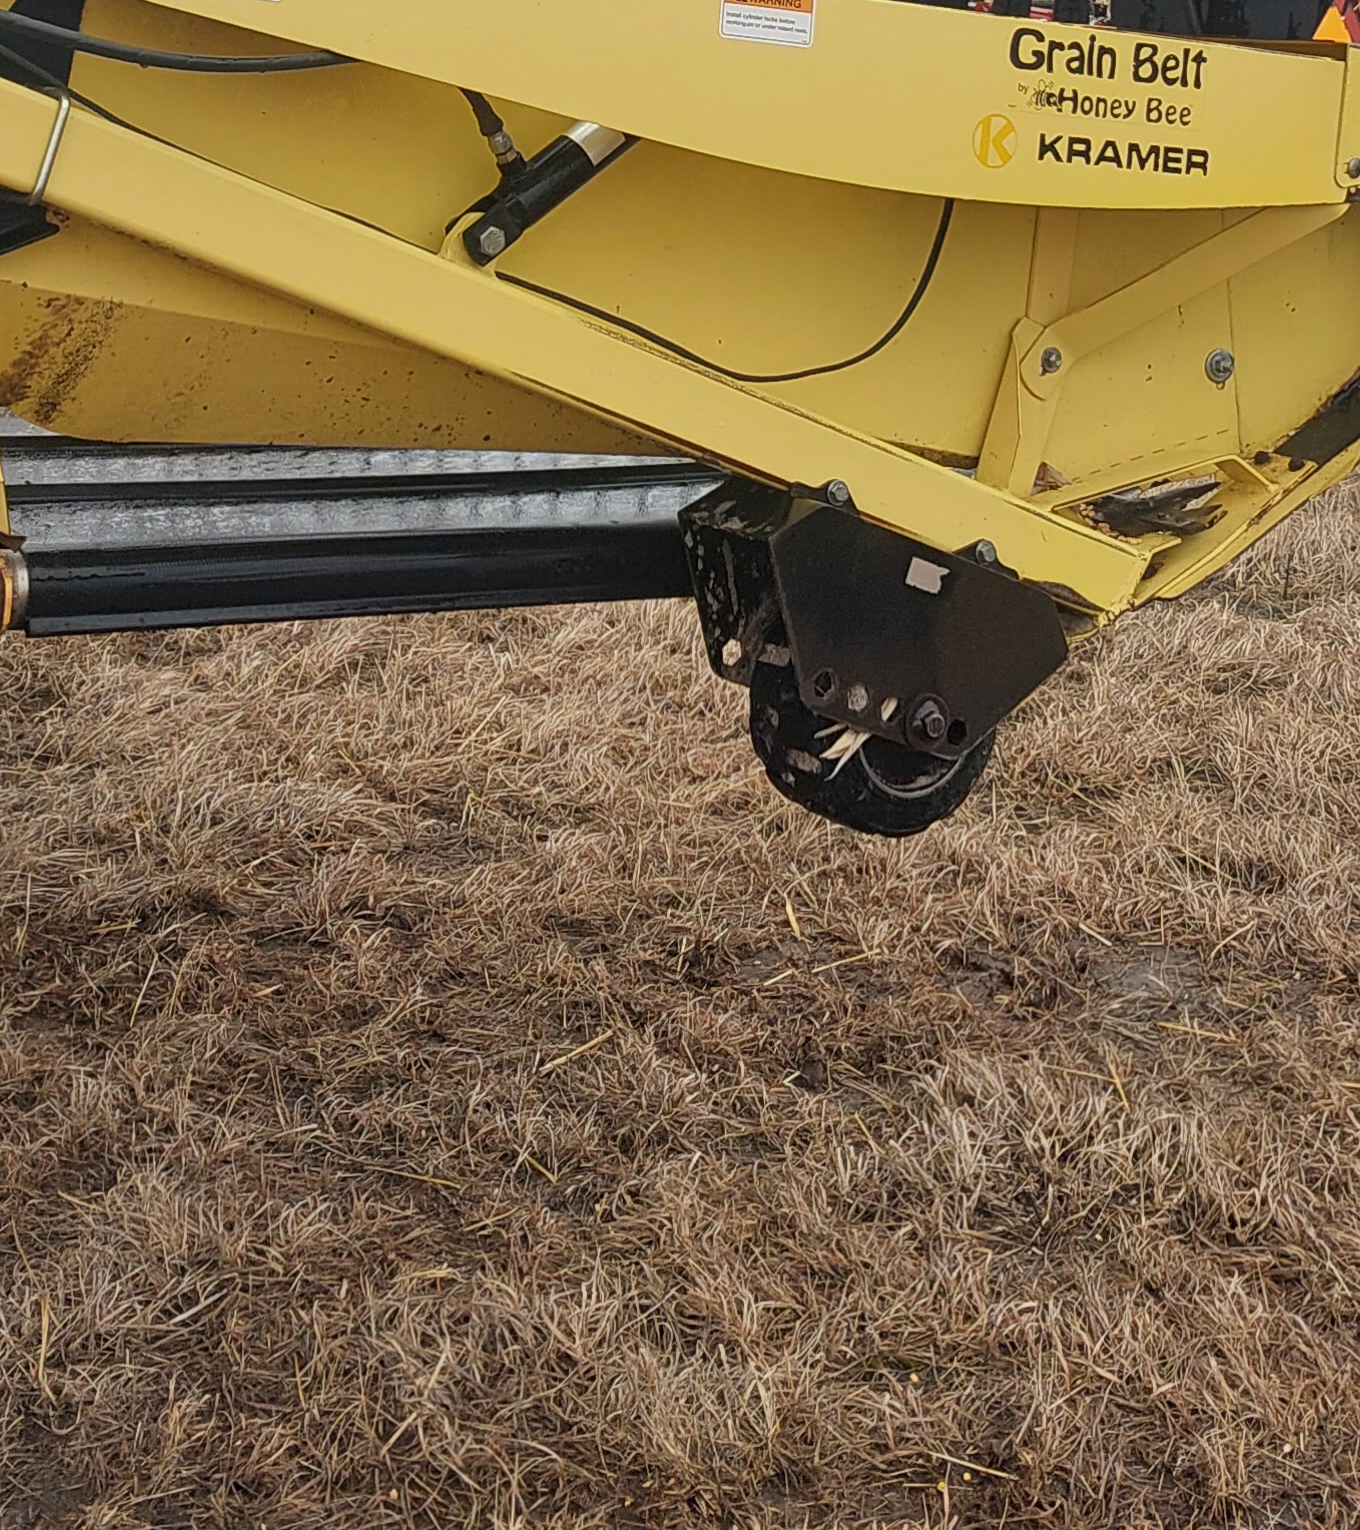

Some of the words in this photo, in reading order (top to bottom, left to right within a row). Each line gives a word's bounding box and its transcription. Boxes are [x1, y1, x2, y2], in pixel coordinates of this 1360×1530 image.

[1009, 27, 1117, 80] Grain
[1132, 42, 1208, 90] Belt
[1017, 82, 1029, 95] by
[1056, 86, 1137, 120] Honey
[1145, 97, 1192, 127] Bee
[1037, 132, 1210, 177] KRAMER
